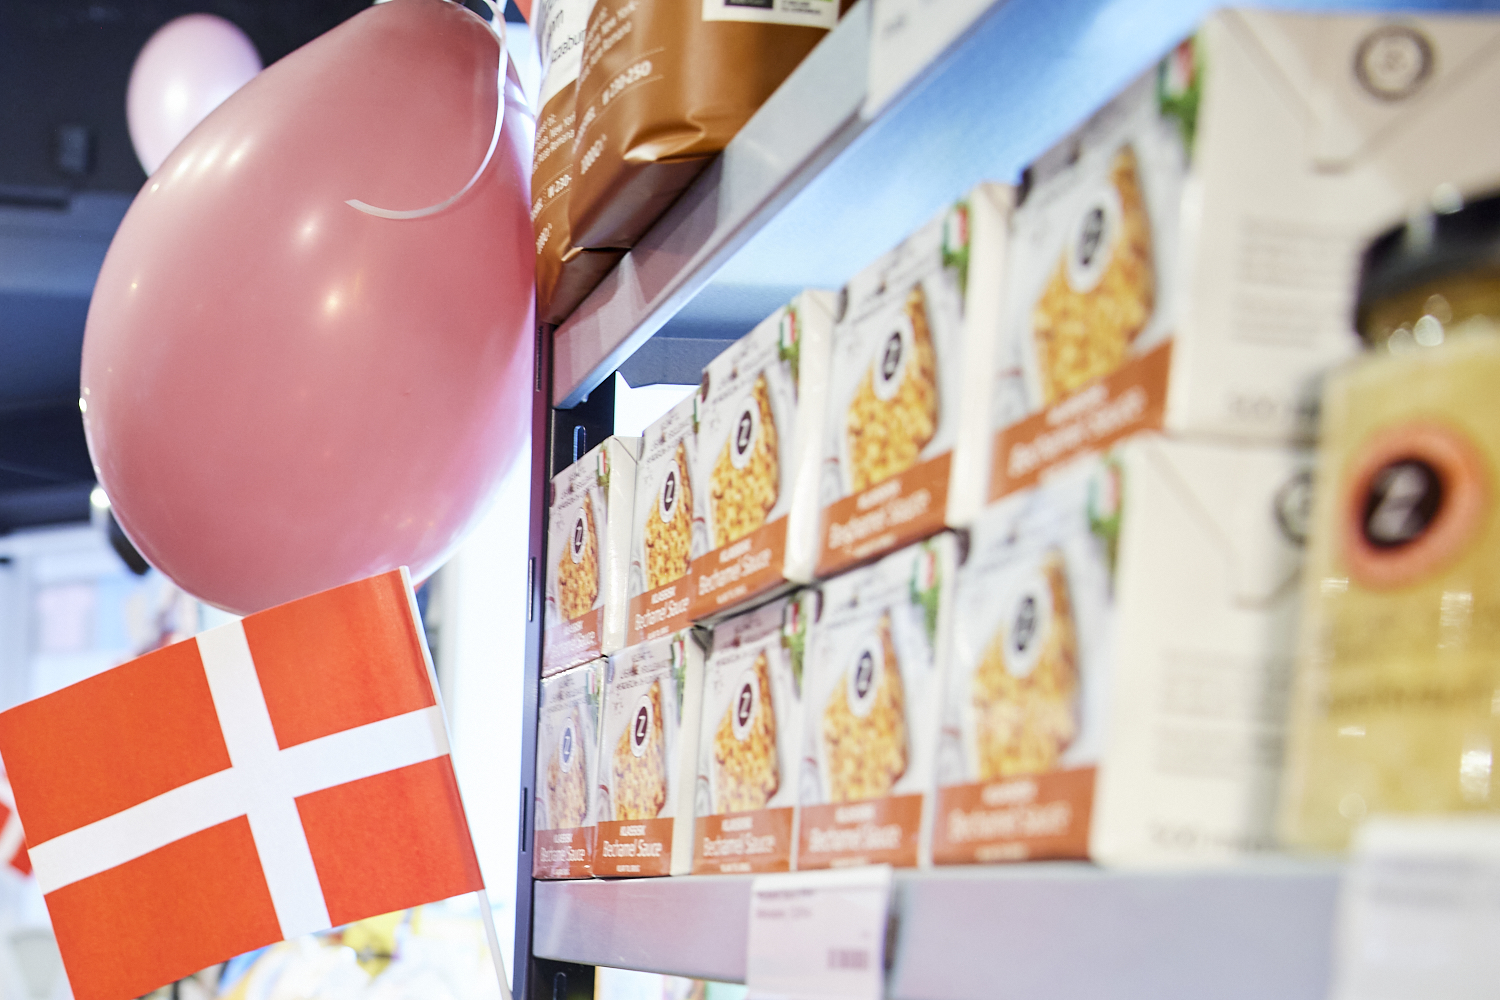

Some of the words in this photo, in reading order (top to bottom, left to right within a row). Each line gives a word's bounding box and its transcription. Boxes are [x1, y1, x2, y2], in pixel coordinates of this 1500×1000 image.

[665, 597, 690, 620] Sauce
[602, 839, 636, 858] Bechamel
[636, 840, 663, 858] Sauce
